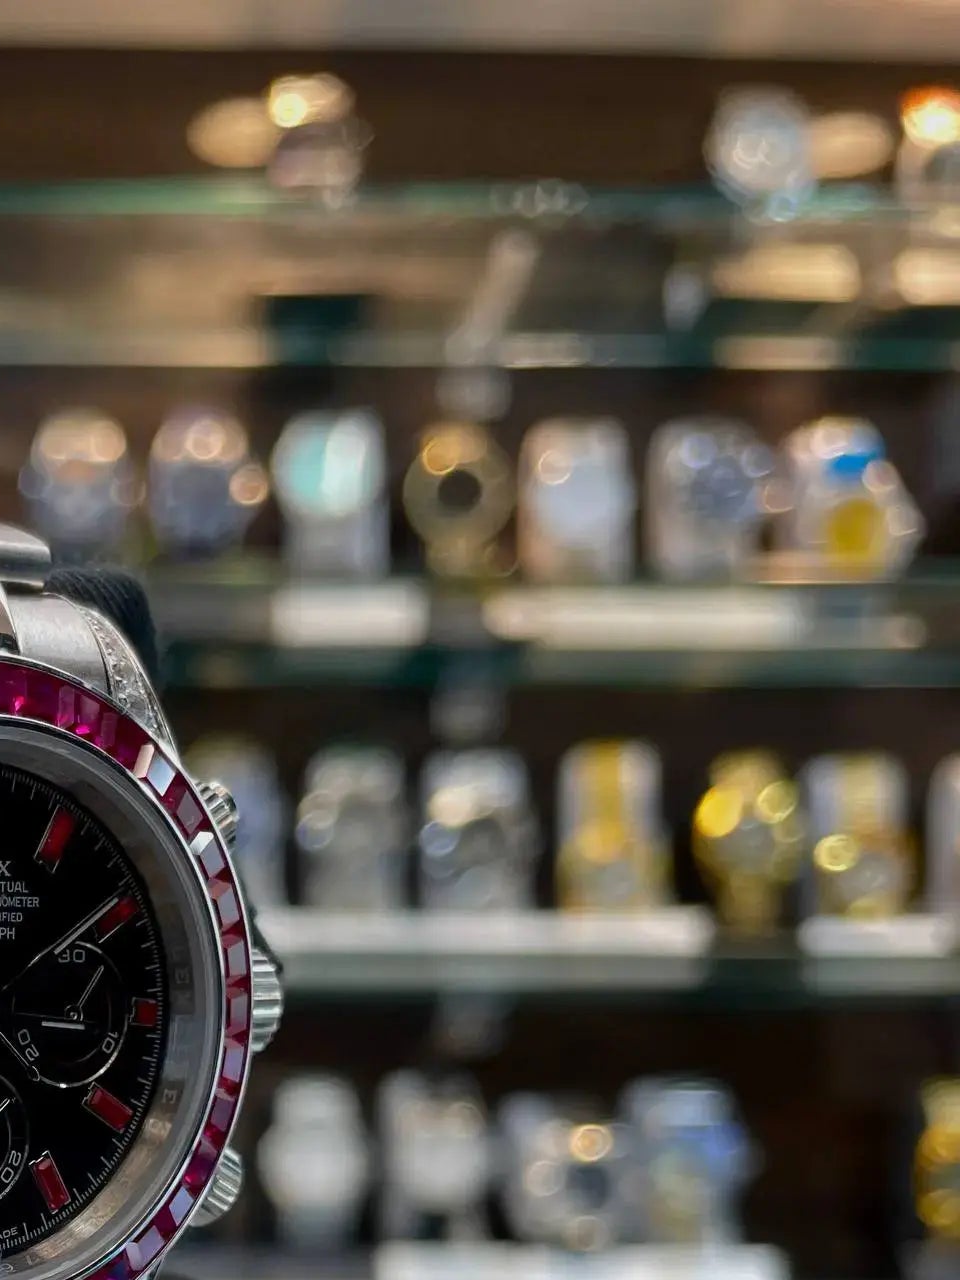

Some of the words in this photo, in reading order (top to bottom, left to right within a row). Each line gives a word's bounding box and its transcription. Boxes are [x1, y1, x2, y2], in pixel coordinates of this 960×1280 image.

[57, 948, 86, 963] 30
[17, 1028, 40, 1062] 20
[101, 1031, 119, 1054] 10
[0, 1150, 22, 1183] 20
